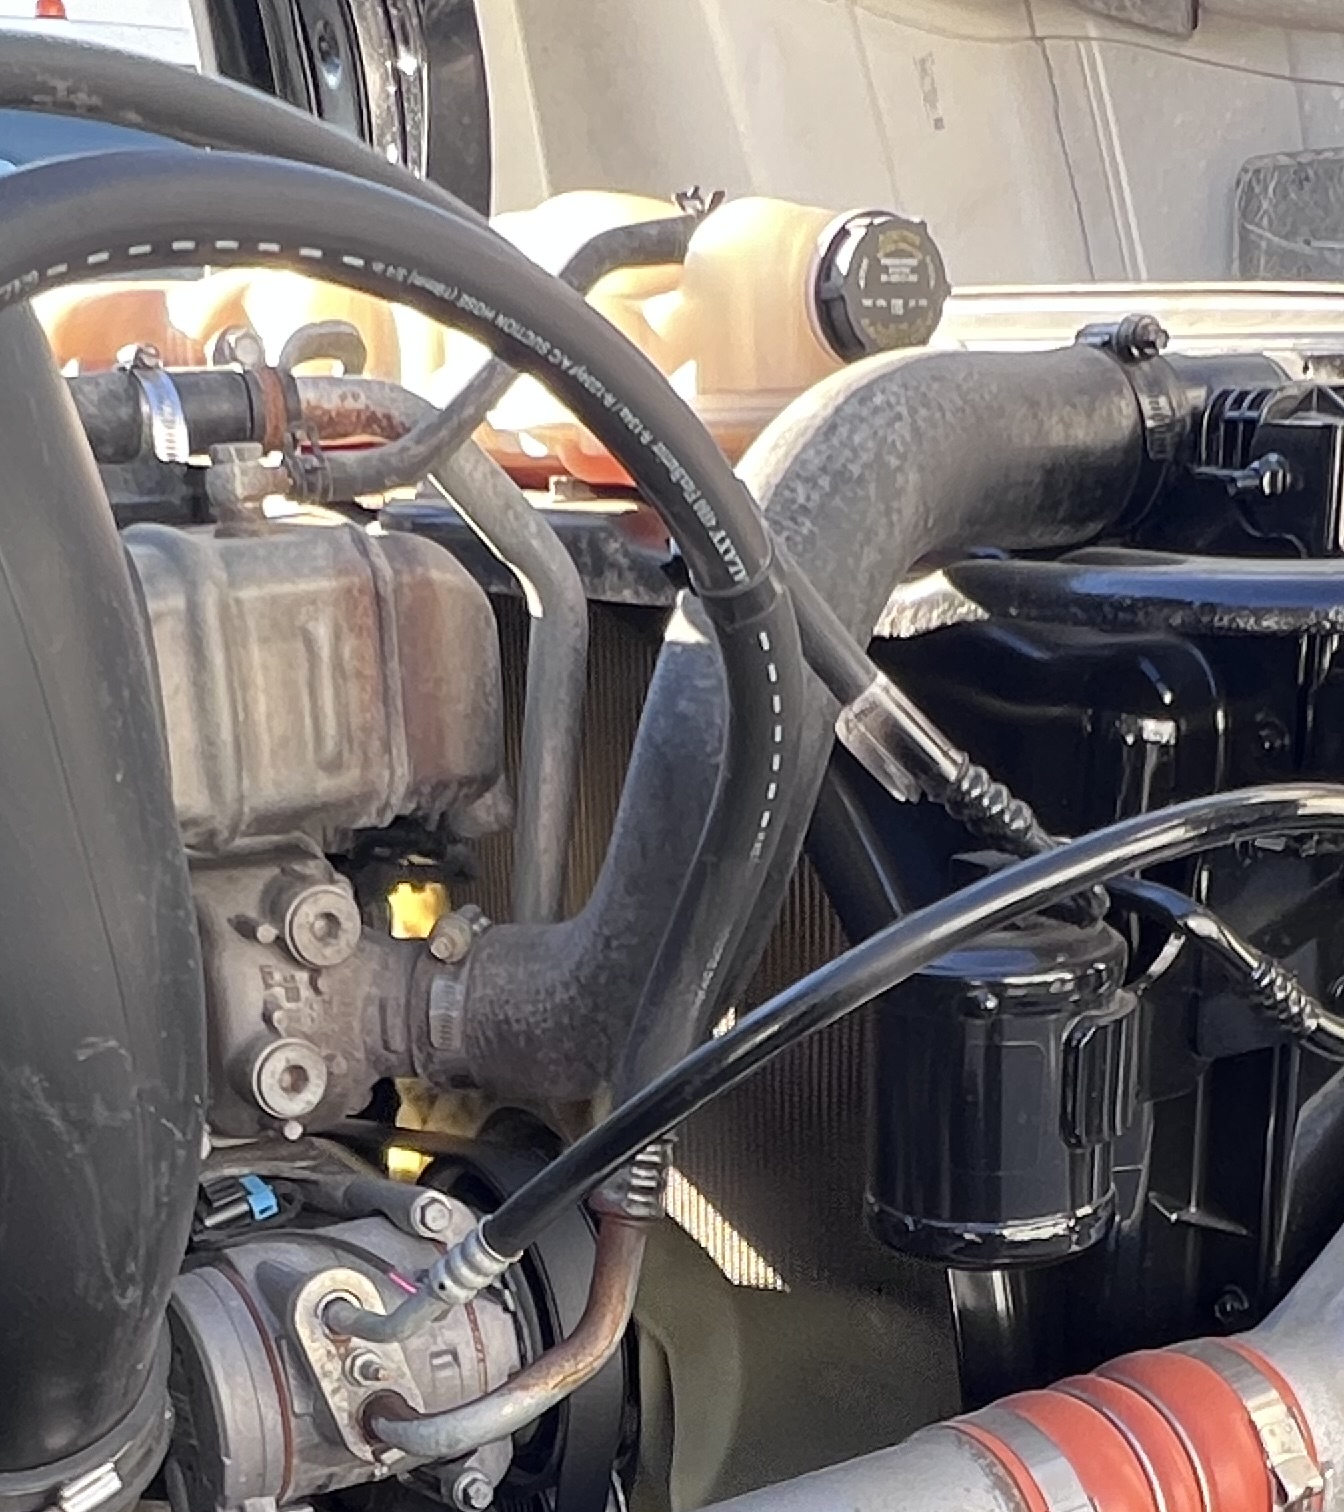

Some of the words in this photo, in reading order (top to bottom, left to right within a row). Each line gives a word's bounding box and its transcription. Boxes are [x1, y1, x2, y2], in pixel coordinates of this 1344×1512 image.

[456, 293, 496, 321] HOSE
[495, 312, 551, 356] SUCTION
[708, 529, 750, 583] ALAXY
